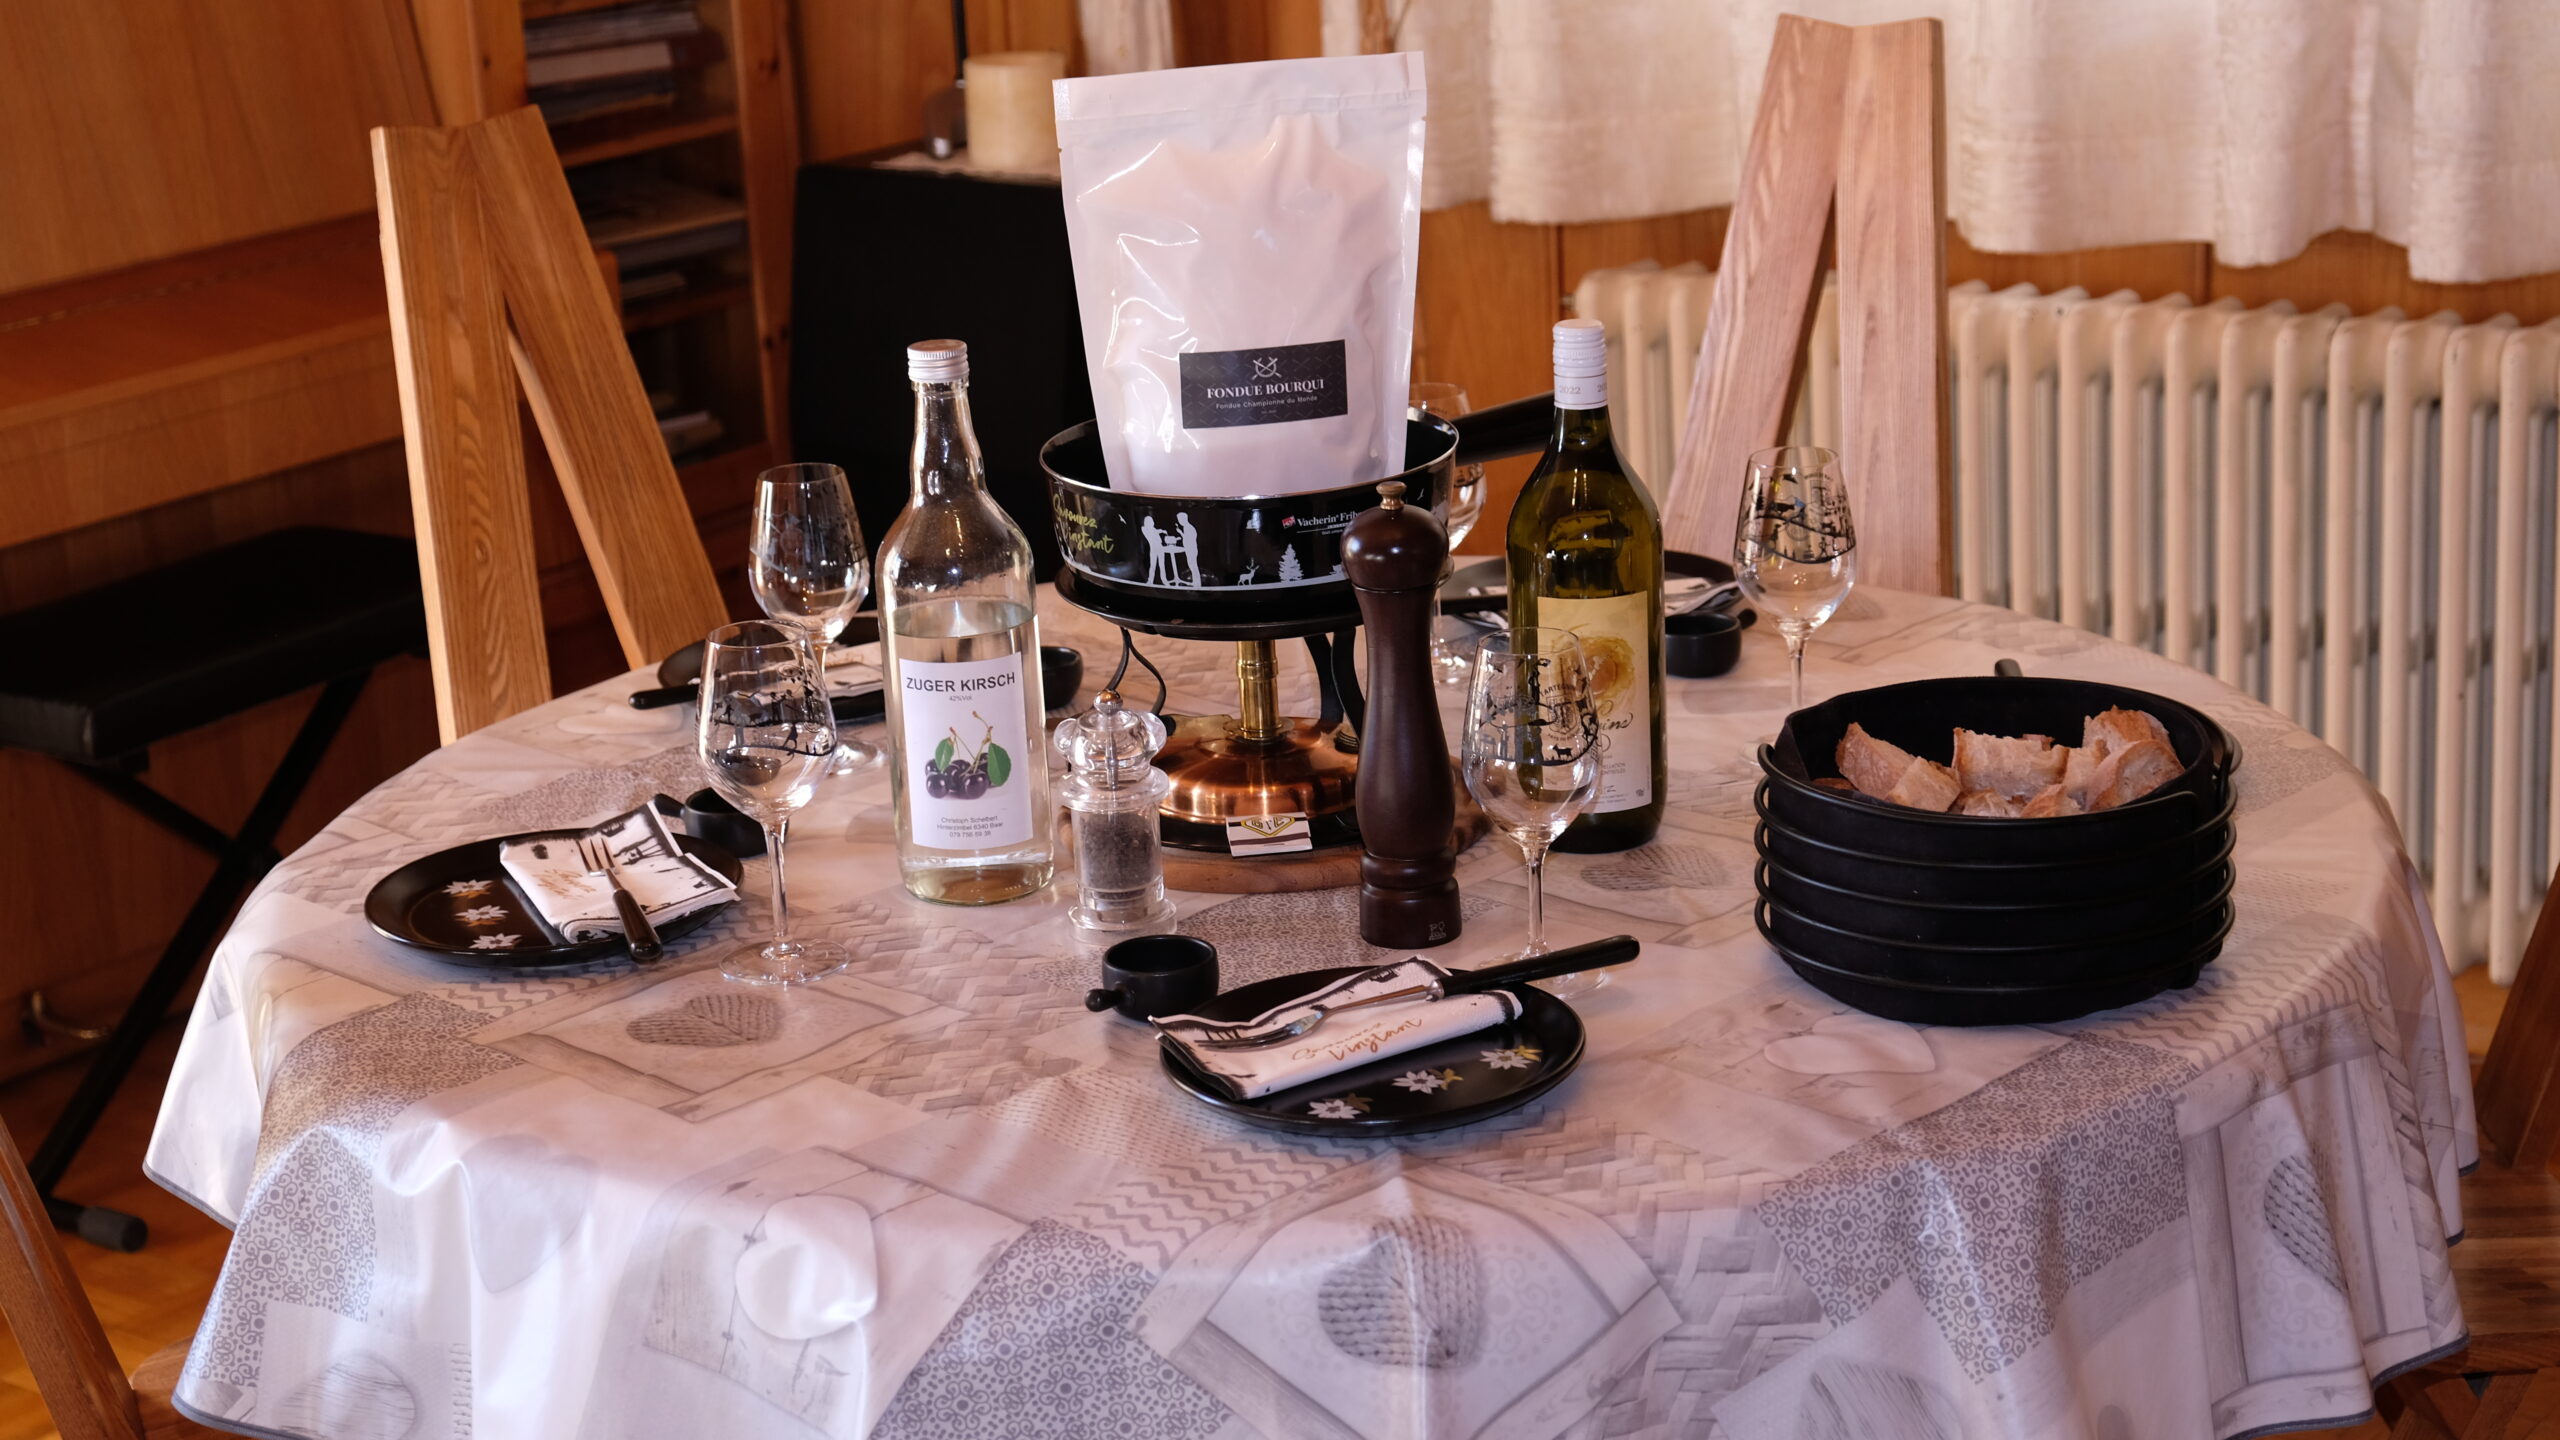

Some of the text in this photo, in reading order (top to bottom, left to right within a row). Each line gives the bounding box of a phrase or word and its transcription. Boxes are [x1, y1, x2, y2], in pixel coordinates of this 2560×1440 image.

[1207, 379, 1324, 399] FONDUE BOURQUI
[906, 672, 1015, 692] ZUGER KIRSCH
